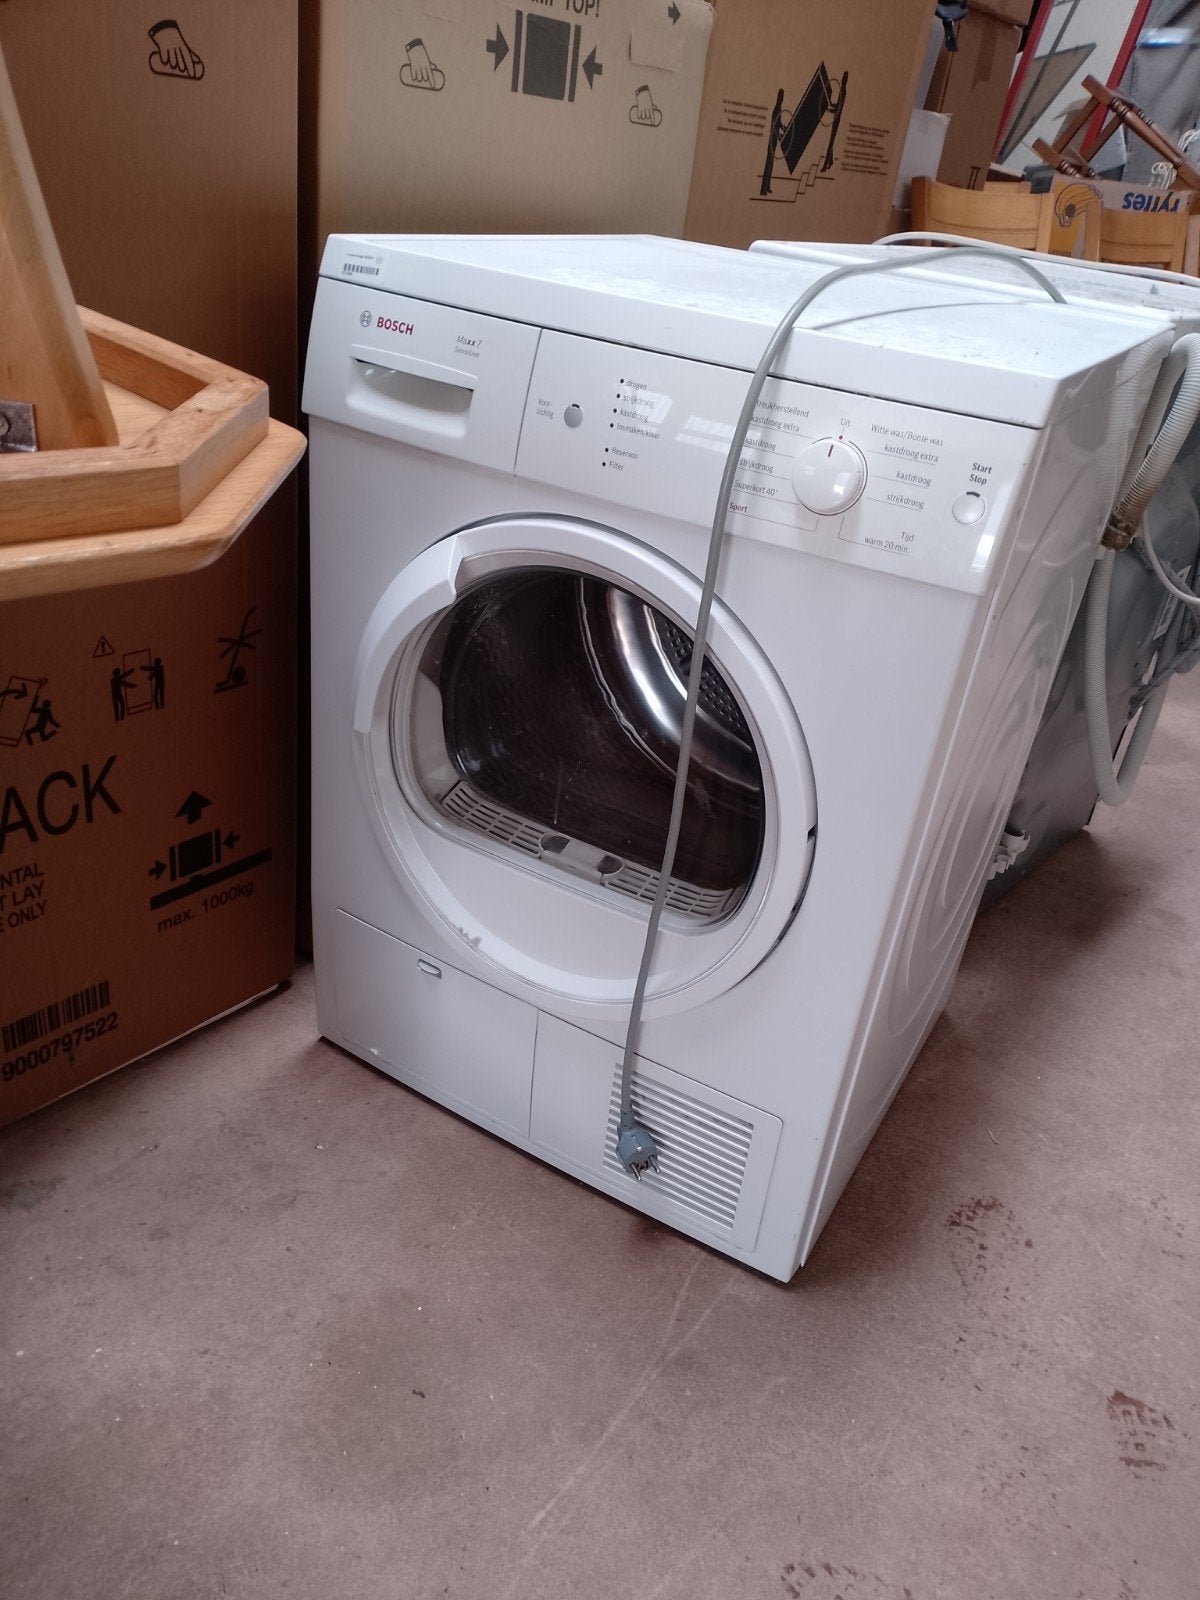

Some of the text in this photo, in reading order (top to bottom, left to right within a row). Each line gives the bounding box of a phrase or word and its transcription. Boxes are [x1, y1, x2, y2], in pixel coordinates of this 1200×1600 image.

[376, 316, 414, 336] BOSCH
[456, 334, 476, 347] Maxx
[454, 345, 480, 358] Sensitive
[626, 380, 647, 391] drogen
[623, 394, 654, 409] strijkdroog
[620, 408, 649, 423] kastdroog
[840, 417, 851, 427] Uit
[783, 423, 800, 433] extra
[871, 423, 944, 447] Witte was/Bonte was
[611, 446, 639, 460] Reservoir
[884, 443, 939, 463] kastdroog extra
[608, 460, 624, 471] Filter
[739, 459, 774, 474] strijkdroog
[971, 462, 992, 474] Start
[896, 470, 932, 487] kastdroog
[968, 473, 988, 486] Stop
[733, 479, 766, 496] Superkort
[729, 501, 748, 513] Sport
[886, 492, 925, 510] strijkdroog
[864, 536, 908, 553] warm 20 min
[901, 531, 915, 543] Tijd
[0, 754, 122, 854] ACK
[0, 862, 45, 890] NTAL
[12, 880, 45, 907] LAY
[8, 899, 48, 928] ONLY
[157, 881, 255, 933] max. 1000kg
[1, 1011, 119, 1082] 9000797522
